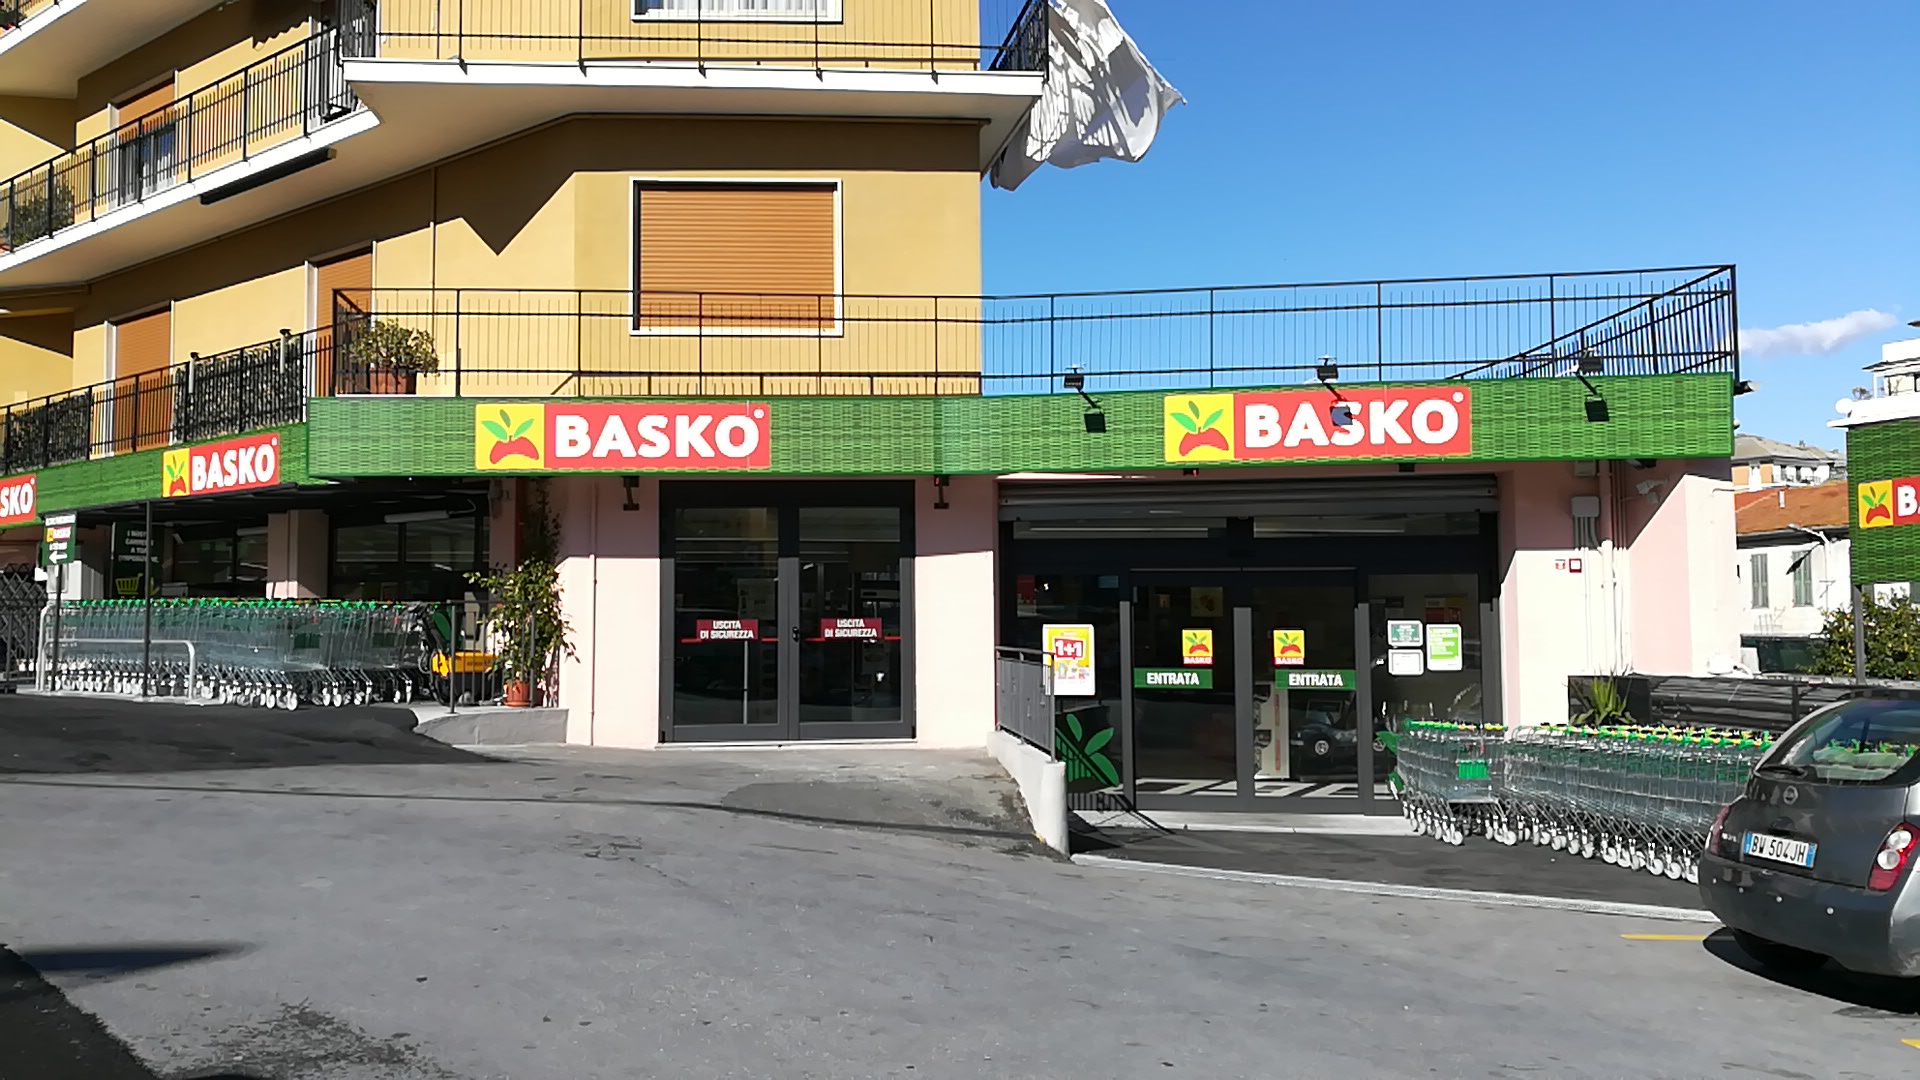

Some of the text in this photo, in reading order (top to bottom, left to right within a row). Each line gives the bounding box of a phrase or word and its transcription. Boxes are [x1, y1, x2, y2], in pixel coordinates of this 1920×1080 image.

[1244, 399, 1460, 448] BASKO
[555, 414, 760, 458] BASKO
[191, 444, 276, 491] BASKO
[1897, 485, 1920, 517] B
[713, 620, 742, 630] USCITA
[837, 618, 865, 628] USCITA
[700, 630, 754, 639] DI SICUREZZA
[824, 628, 877, 638] DI SICUREZZA
[1055, 640, 1083, 657] 1+1
[1183, 656, 1212, 665] BASKO
[1275, 657, 1304, 665] BASKO
[1146, 672, 1200, 686] ENTRATA
[1288, 673, 1344, 687] ENTRATA
[1752, 836, 1765, 854] BW
[1768, 839, 1807, 862] 504JH
